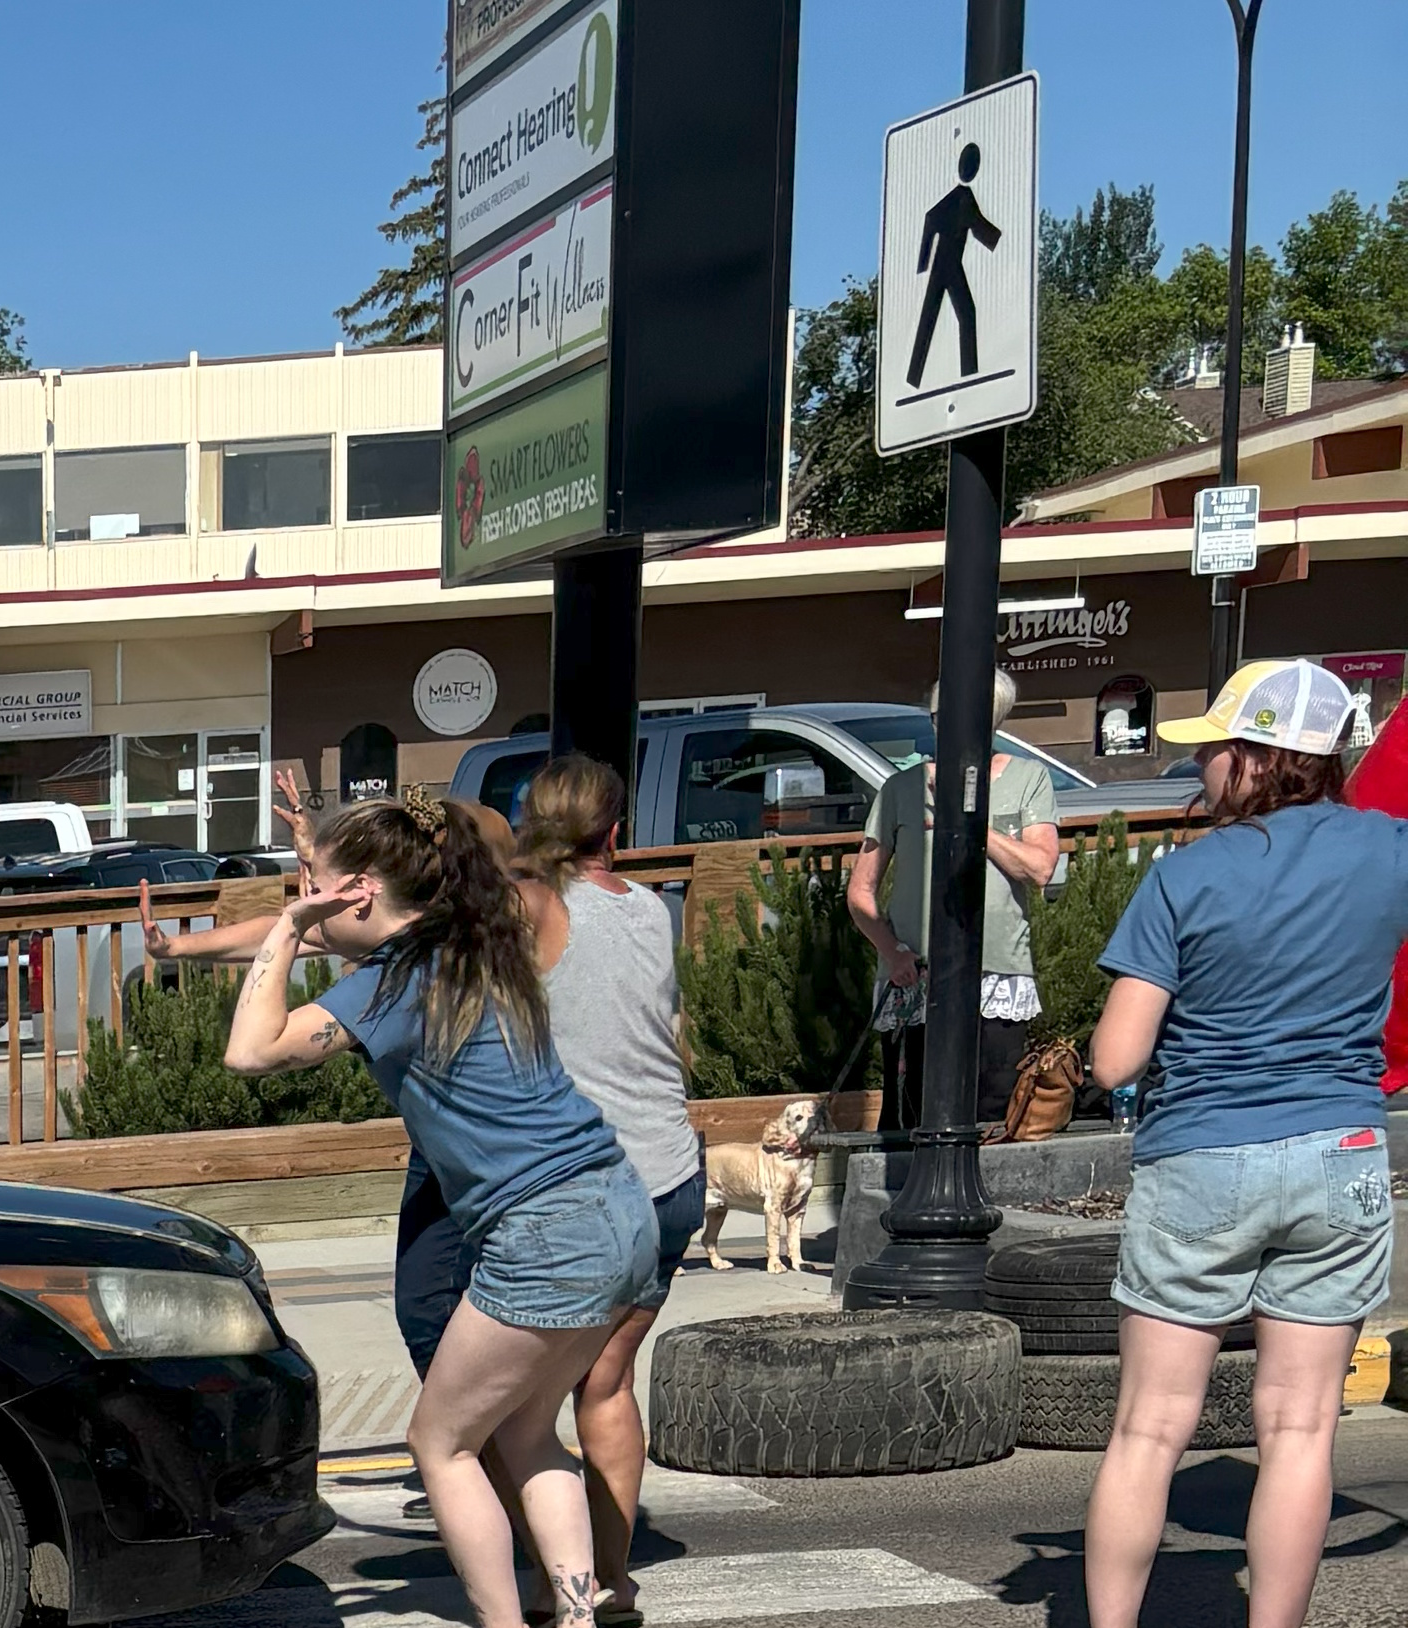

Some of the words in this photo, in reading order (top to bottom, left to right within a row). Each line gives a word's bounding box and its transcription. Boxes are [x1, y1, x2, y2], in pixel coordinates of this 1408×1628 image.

[458, 120, 513, 200] Connect
[517, 82, 576, 161] Hearing
[546, 201, 606, 362] Wellness
[489, 443, 530, 500] SMART
[532, 418, 590, 483] FLOWERS
[480, 510, 505, 545] FRESH
[544, 484, 571, 523] FRESH
[32, 709, 83, 722] Services
[36, 692, 82, 705] GROUP
[428, 680, 481, 697] MATCH
